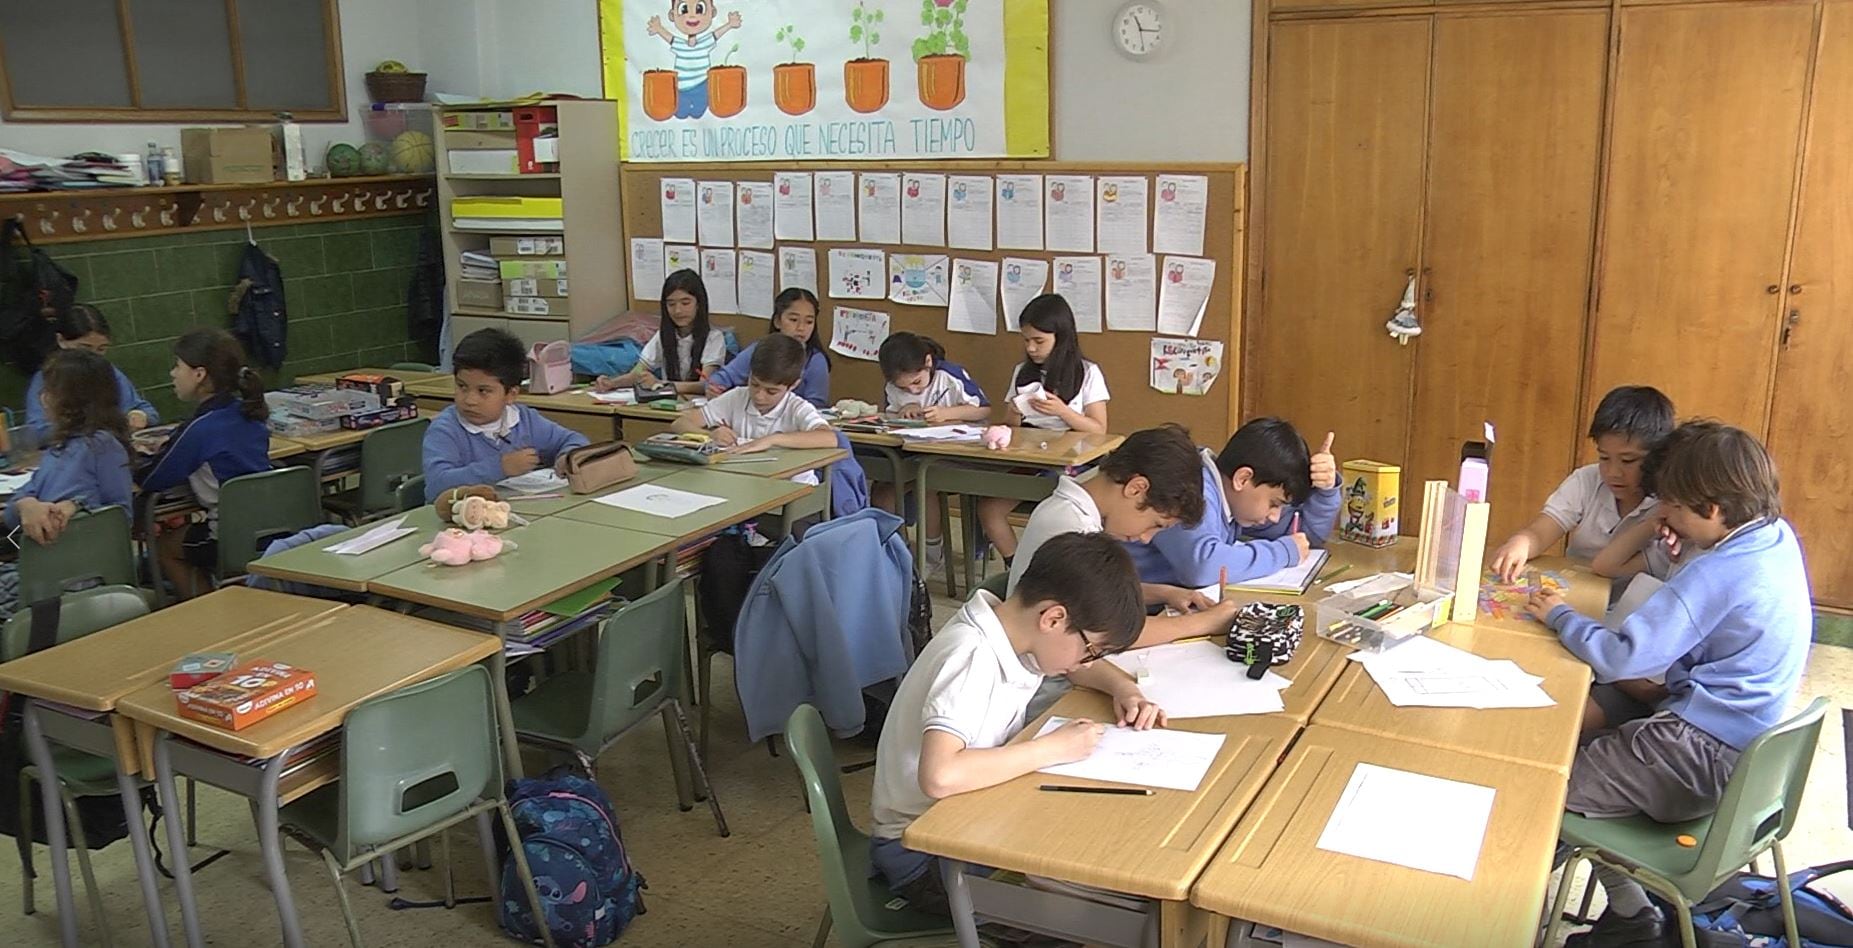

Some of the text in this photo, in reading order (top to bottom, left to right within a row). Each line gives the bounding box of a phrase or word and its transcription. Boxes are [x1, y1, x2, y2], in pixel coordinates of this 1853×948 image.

[682, 128, 698, 158] ES
[785, 123, 812, 156] QUE
[818, 120, 896, 155] NECESITA
[909, 117, 975, 153] TIEMPO
[254, 692, 284, 710] ADIVINA
